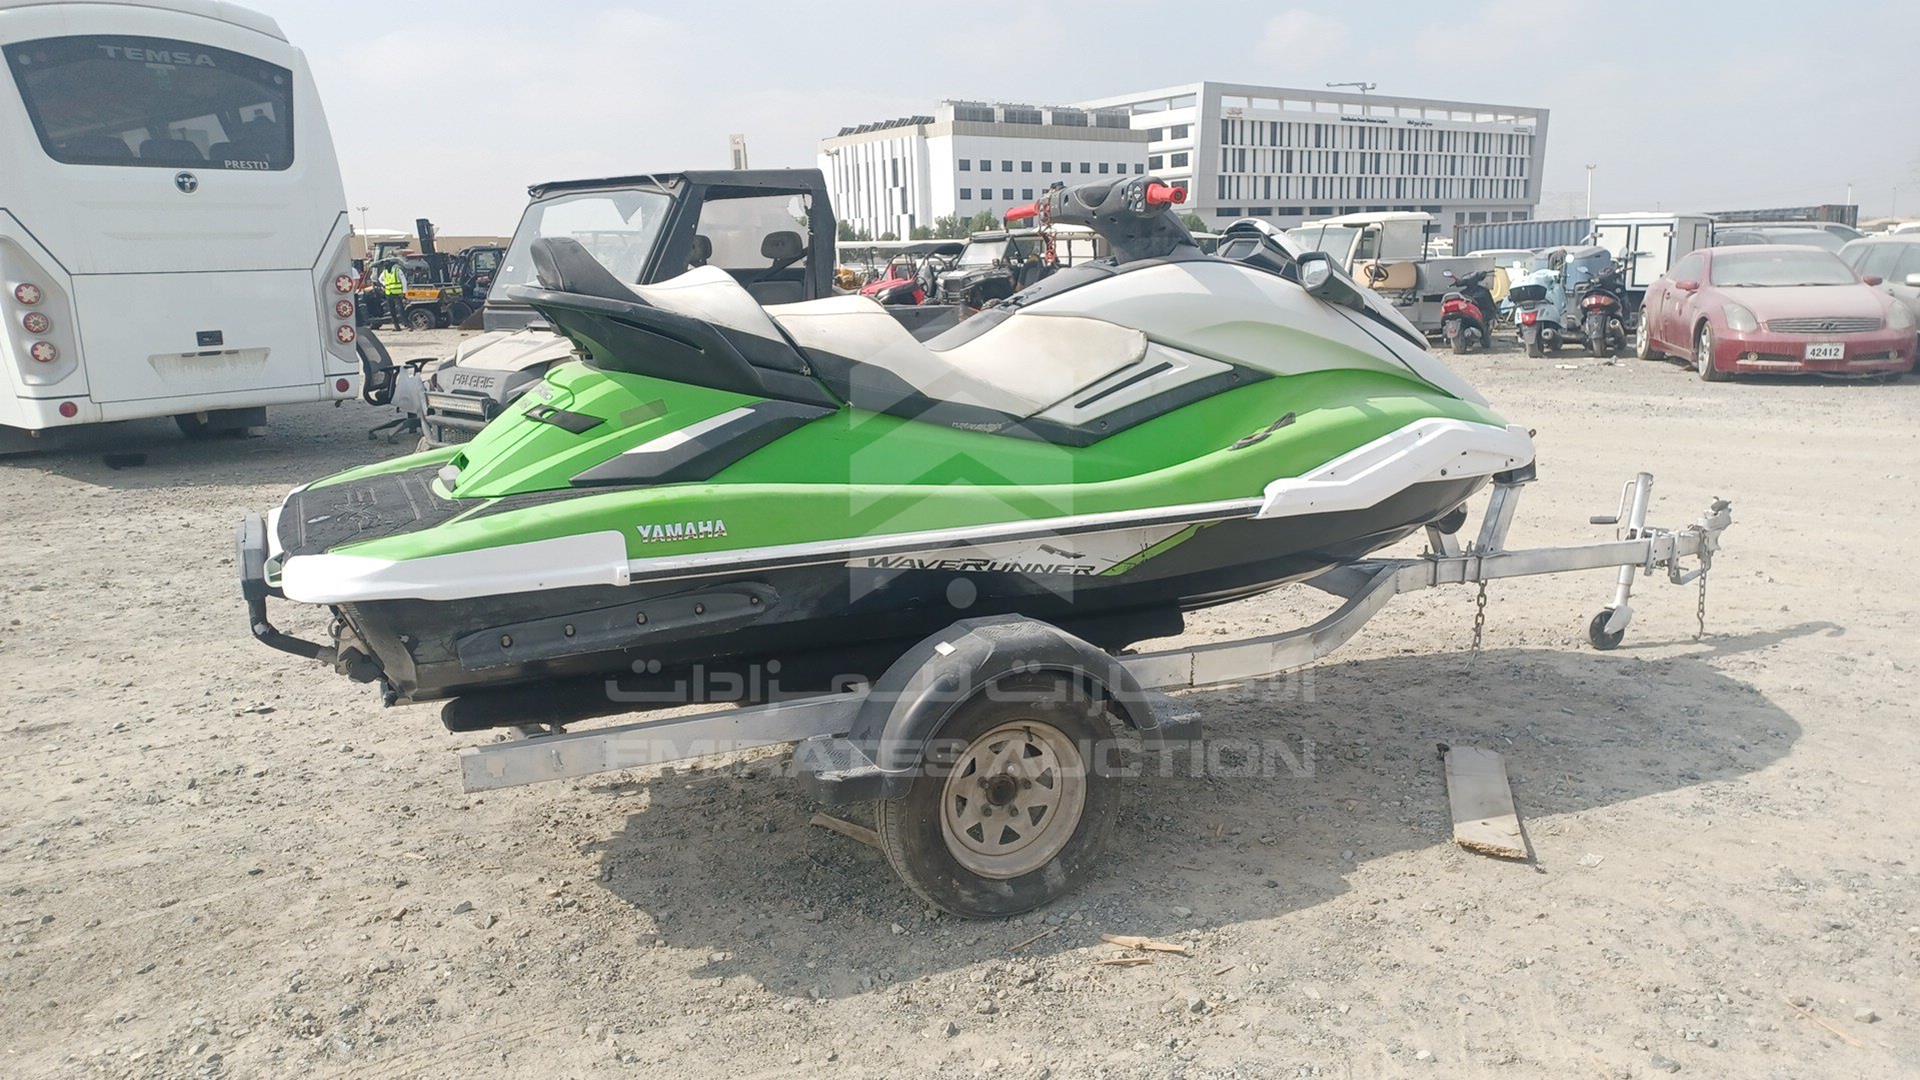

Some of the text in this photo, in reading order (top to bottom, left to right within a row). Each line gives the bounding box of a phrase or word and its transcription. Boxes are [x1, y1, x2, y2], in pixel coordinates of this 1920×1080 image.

[98, 45, 216, 67] TEMSA
[1810, 347, 1840, 357] 42412
[452, 373, 495, 389] POLARIS
[636, 519, 728, 543] YAMAHA
[867, 555, 1096, 576] WAVERUNNER
